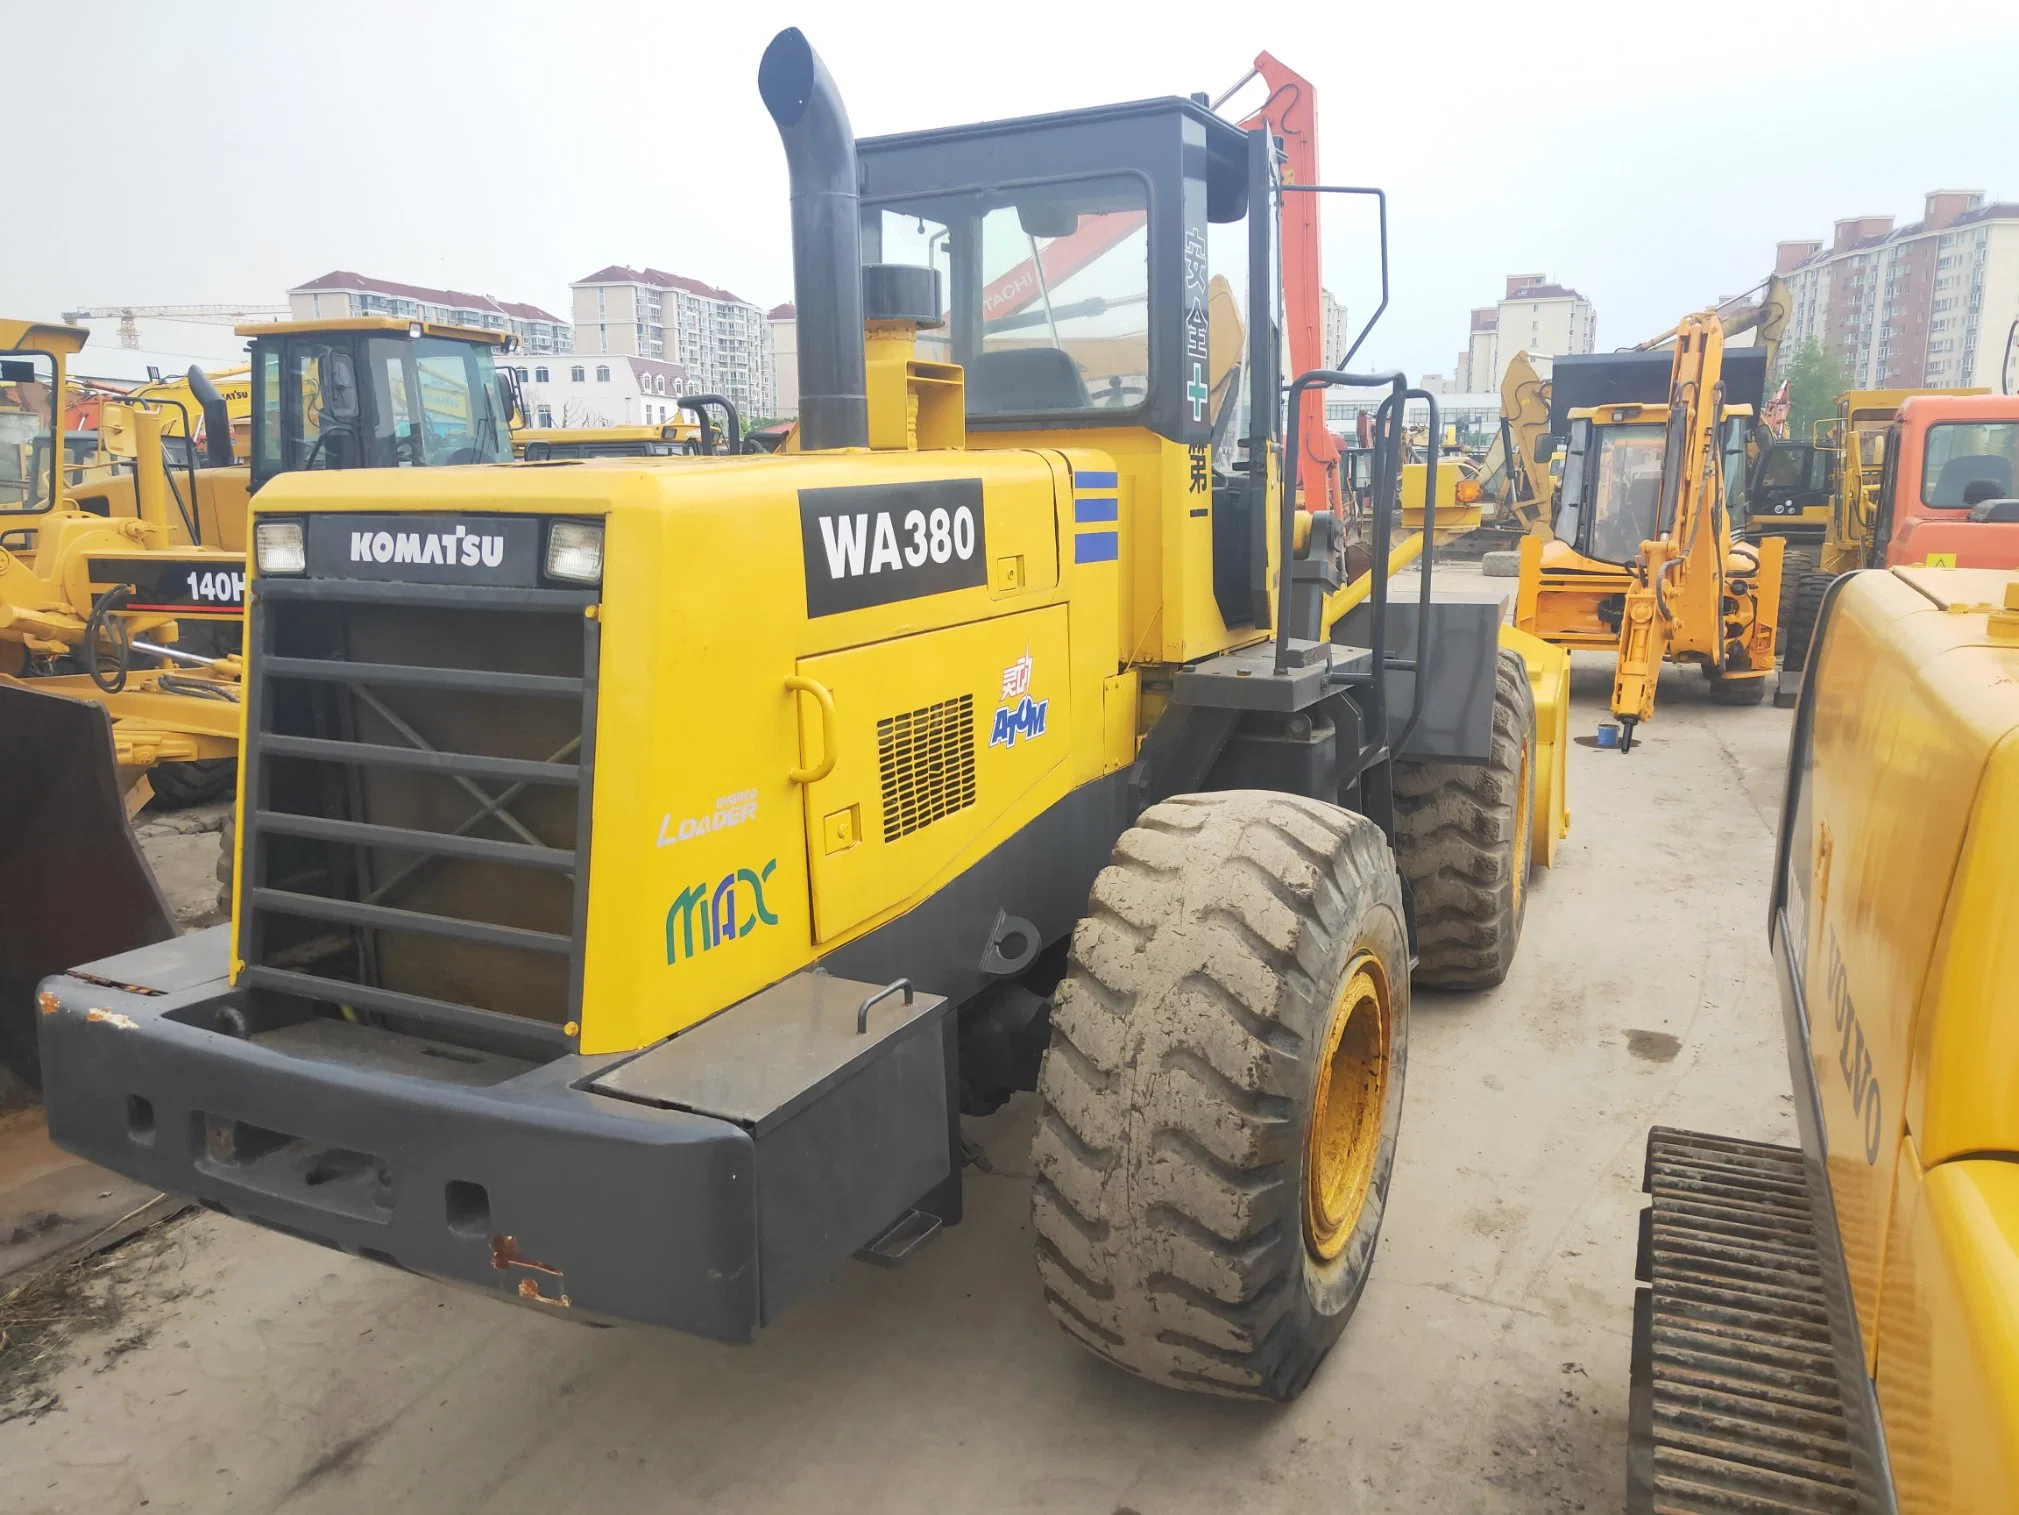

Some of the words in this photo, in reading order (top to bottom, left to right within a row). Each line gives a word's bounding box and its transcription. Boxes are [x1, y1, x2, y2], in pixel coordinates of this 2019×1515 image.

[1184, 227, 1208, 359] 安全
[1188, 444, 1209, 518] 第一
[350, 525, 504, 567] KOMATSU
[818, 505, 975, 580] WA380
[989, 694, 1049, 749] ATOM
[1827, 921, 1881, 1166] VOLVO
